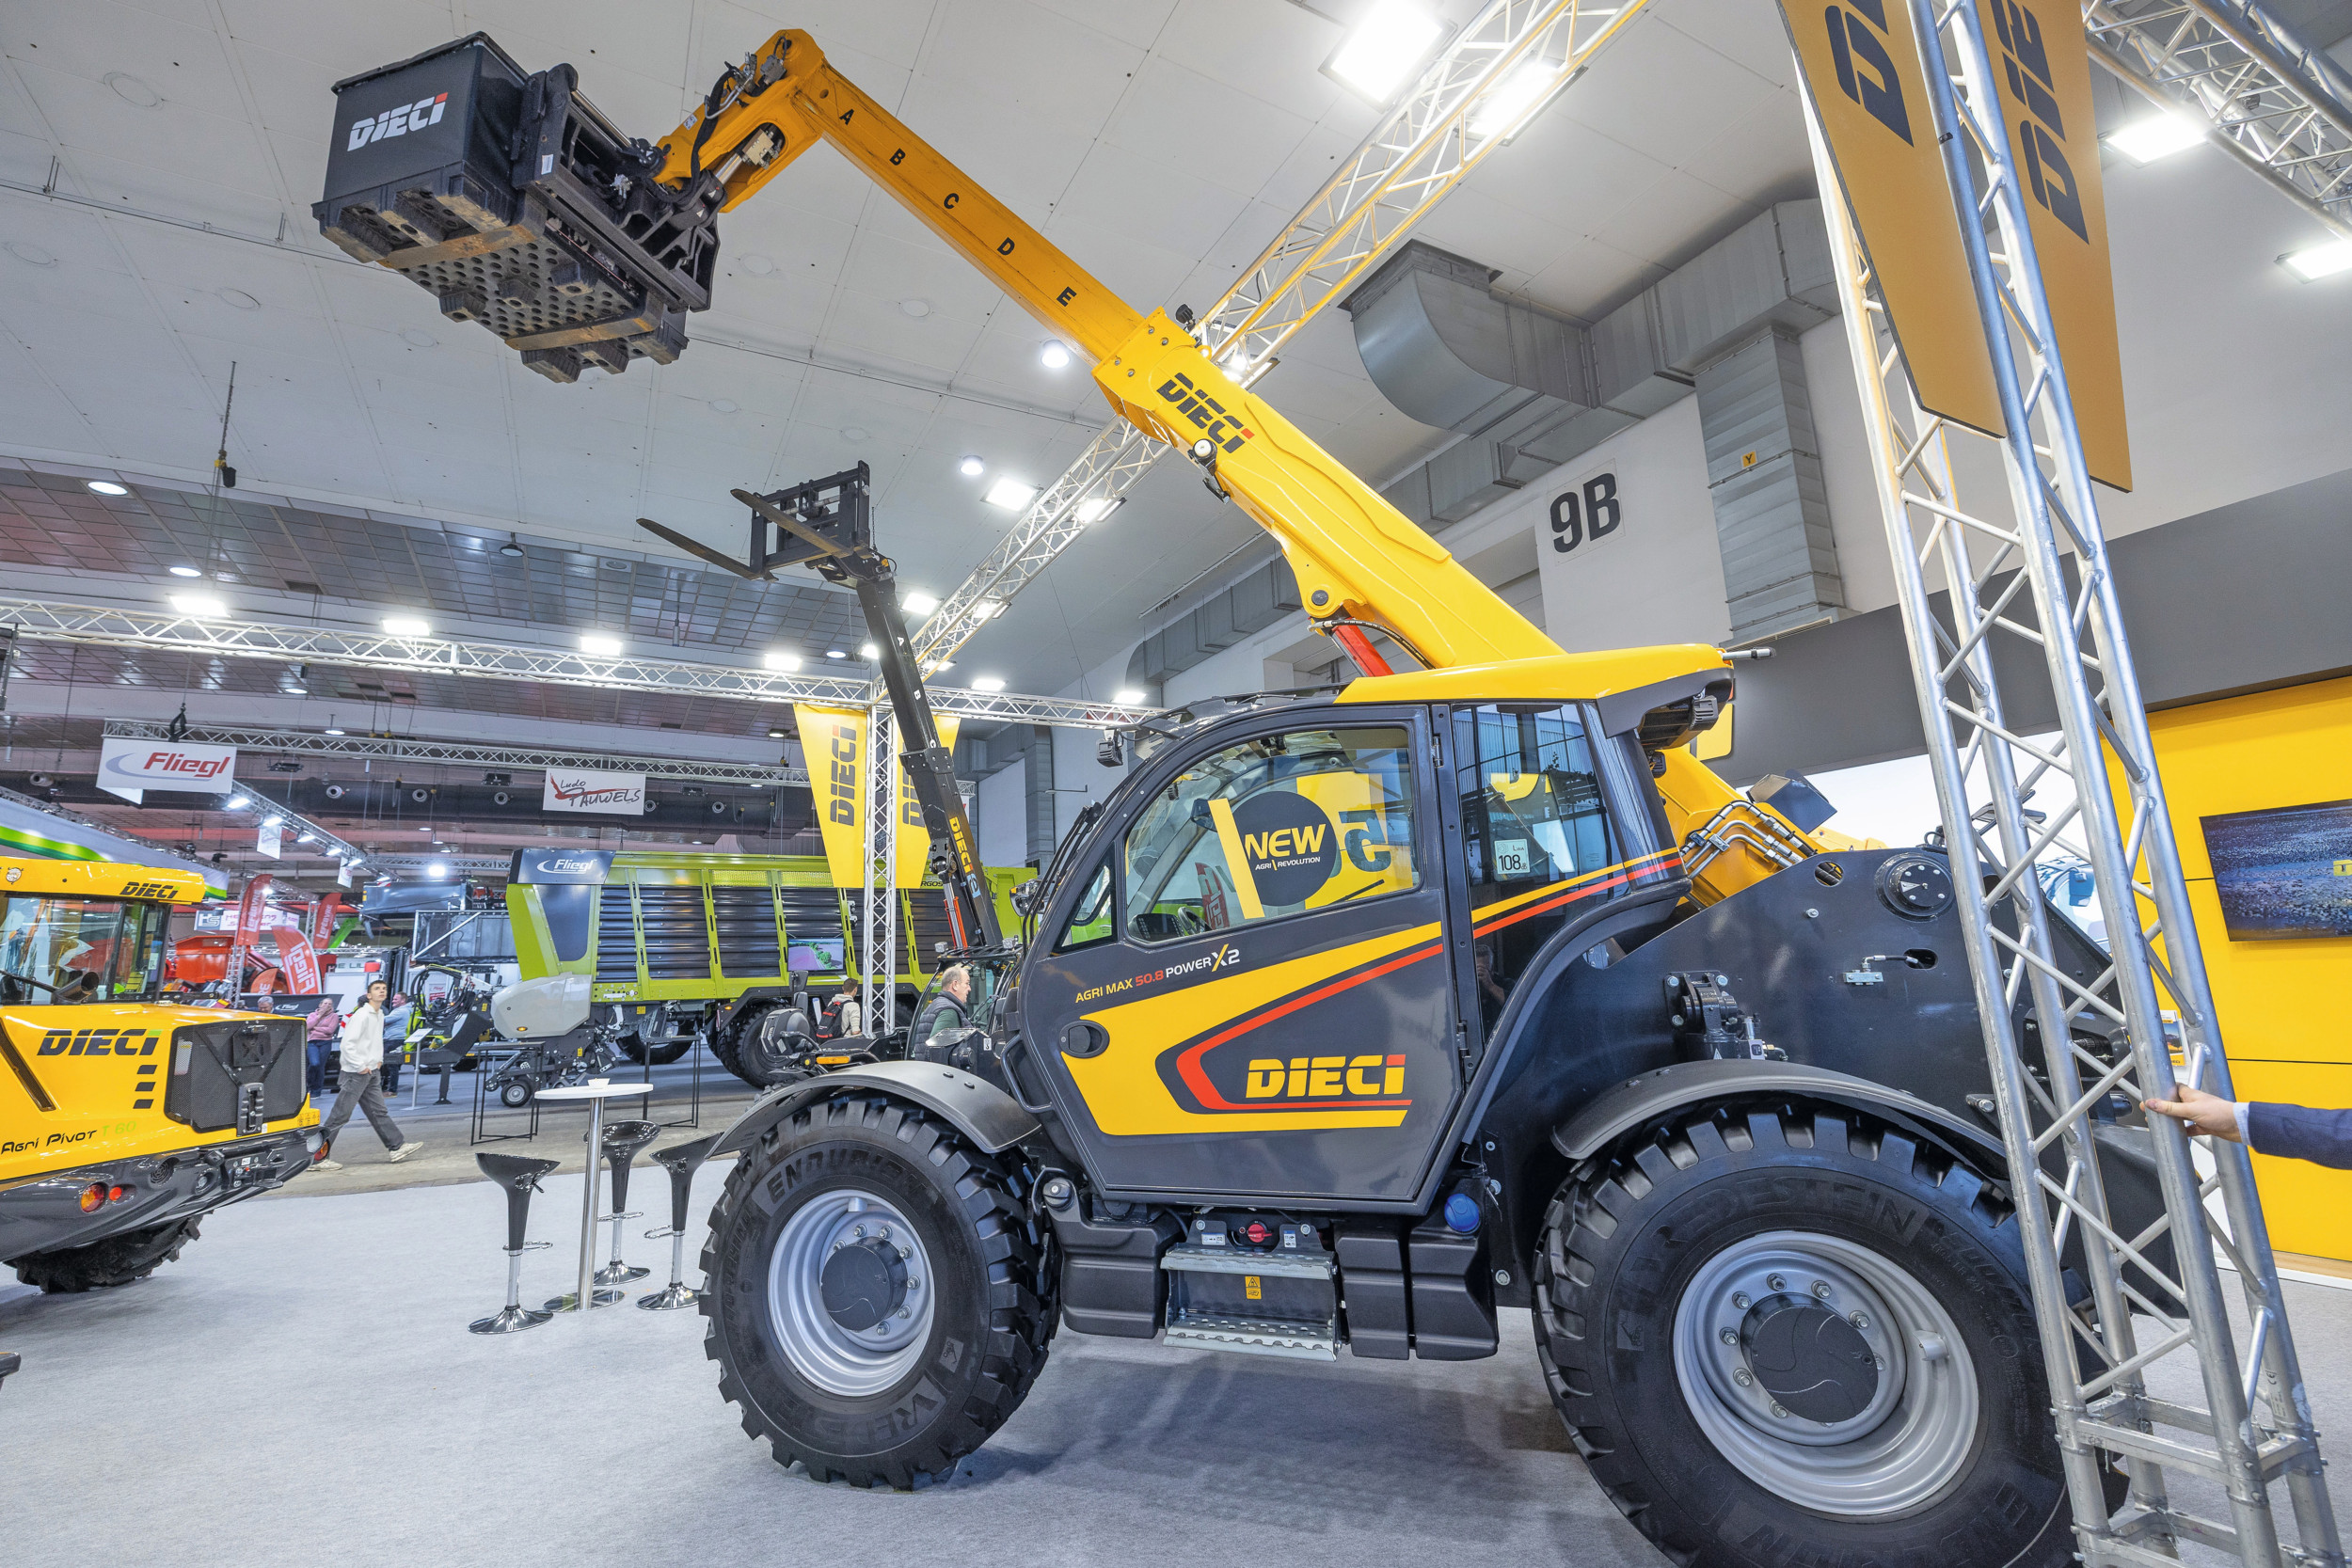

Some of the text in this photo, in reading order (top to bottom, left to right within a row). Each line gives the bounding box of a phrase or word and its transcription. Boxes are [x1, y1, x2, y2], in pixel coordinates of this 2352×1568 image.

[347, 92, 449, 151] DIECI
[1991, 0, 2090, 245] DIE
[839, 108, 1077, 307] A B C D E
[1156, 372, 1255, 453] DIECI
[1549, 472, 1621, 553] 9B
[143, 752, 231, 778] Fliegl
[830, 720, 857, 827] DIECI
[560, 779, 587, 789] Ludo
[562, 786, 642, 807] PAUWELS
[949, 816, 974, 874] DIECI
[1245, 824, 1327, 861] NEW
[553, 858, 595, 875] Fliegl
[1255, 856, 1321, 871] AGRI REVOLUTION
[1498, 854, 1521, 871] 108
[119, 881, 181, 899] DIECI
[1075, 987, 1104, 1004] AGRI
[1105, 978, 1134, 995] MAX
[1135, 970, 1165, 987] 50.8
[37, 1028, 163, 1056] DIECI
[1246, 1054, 1406, 1099] DIECI
[114, 1120, 137, 1134] 60
